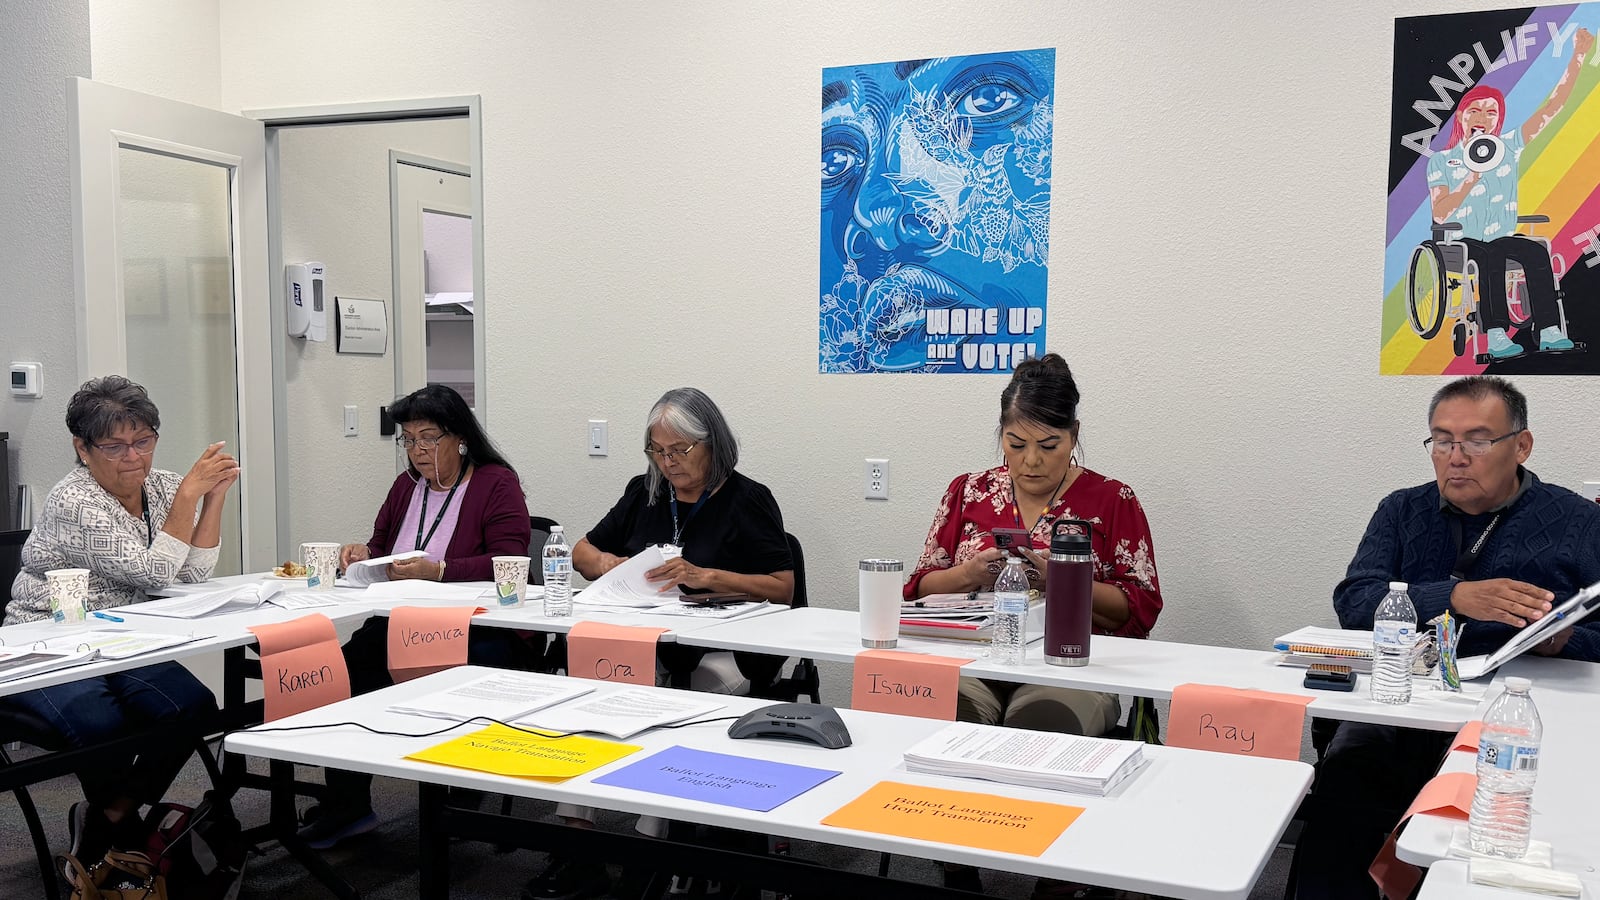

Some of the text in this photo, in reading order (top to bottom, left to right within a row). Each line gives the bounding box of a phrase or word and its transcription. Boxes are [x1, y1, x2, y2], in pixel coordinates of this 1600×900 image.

[1400, 21, 1580, 159] AMPLIFY
[926, 307, 1043, 334] WAKE UP
[927, 343, 957, 359] AND
[401, 627, 465, 648] Veronica
[1062, 645, 1081, 653] YETI
[595, 658, 635, 679] Ora
[867, 673, 936, 699] Isaura
[1199, 713, 1255, 752] Ray
[660, 766, 777, 789] Ballot Language
[677, 776, 732, 790] English
[882, 803, 1028, 829] Hopi Translation
[892, 797, 1034, 822] Ballot Language
